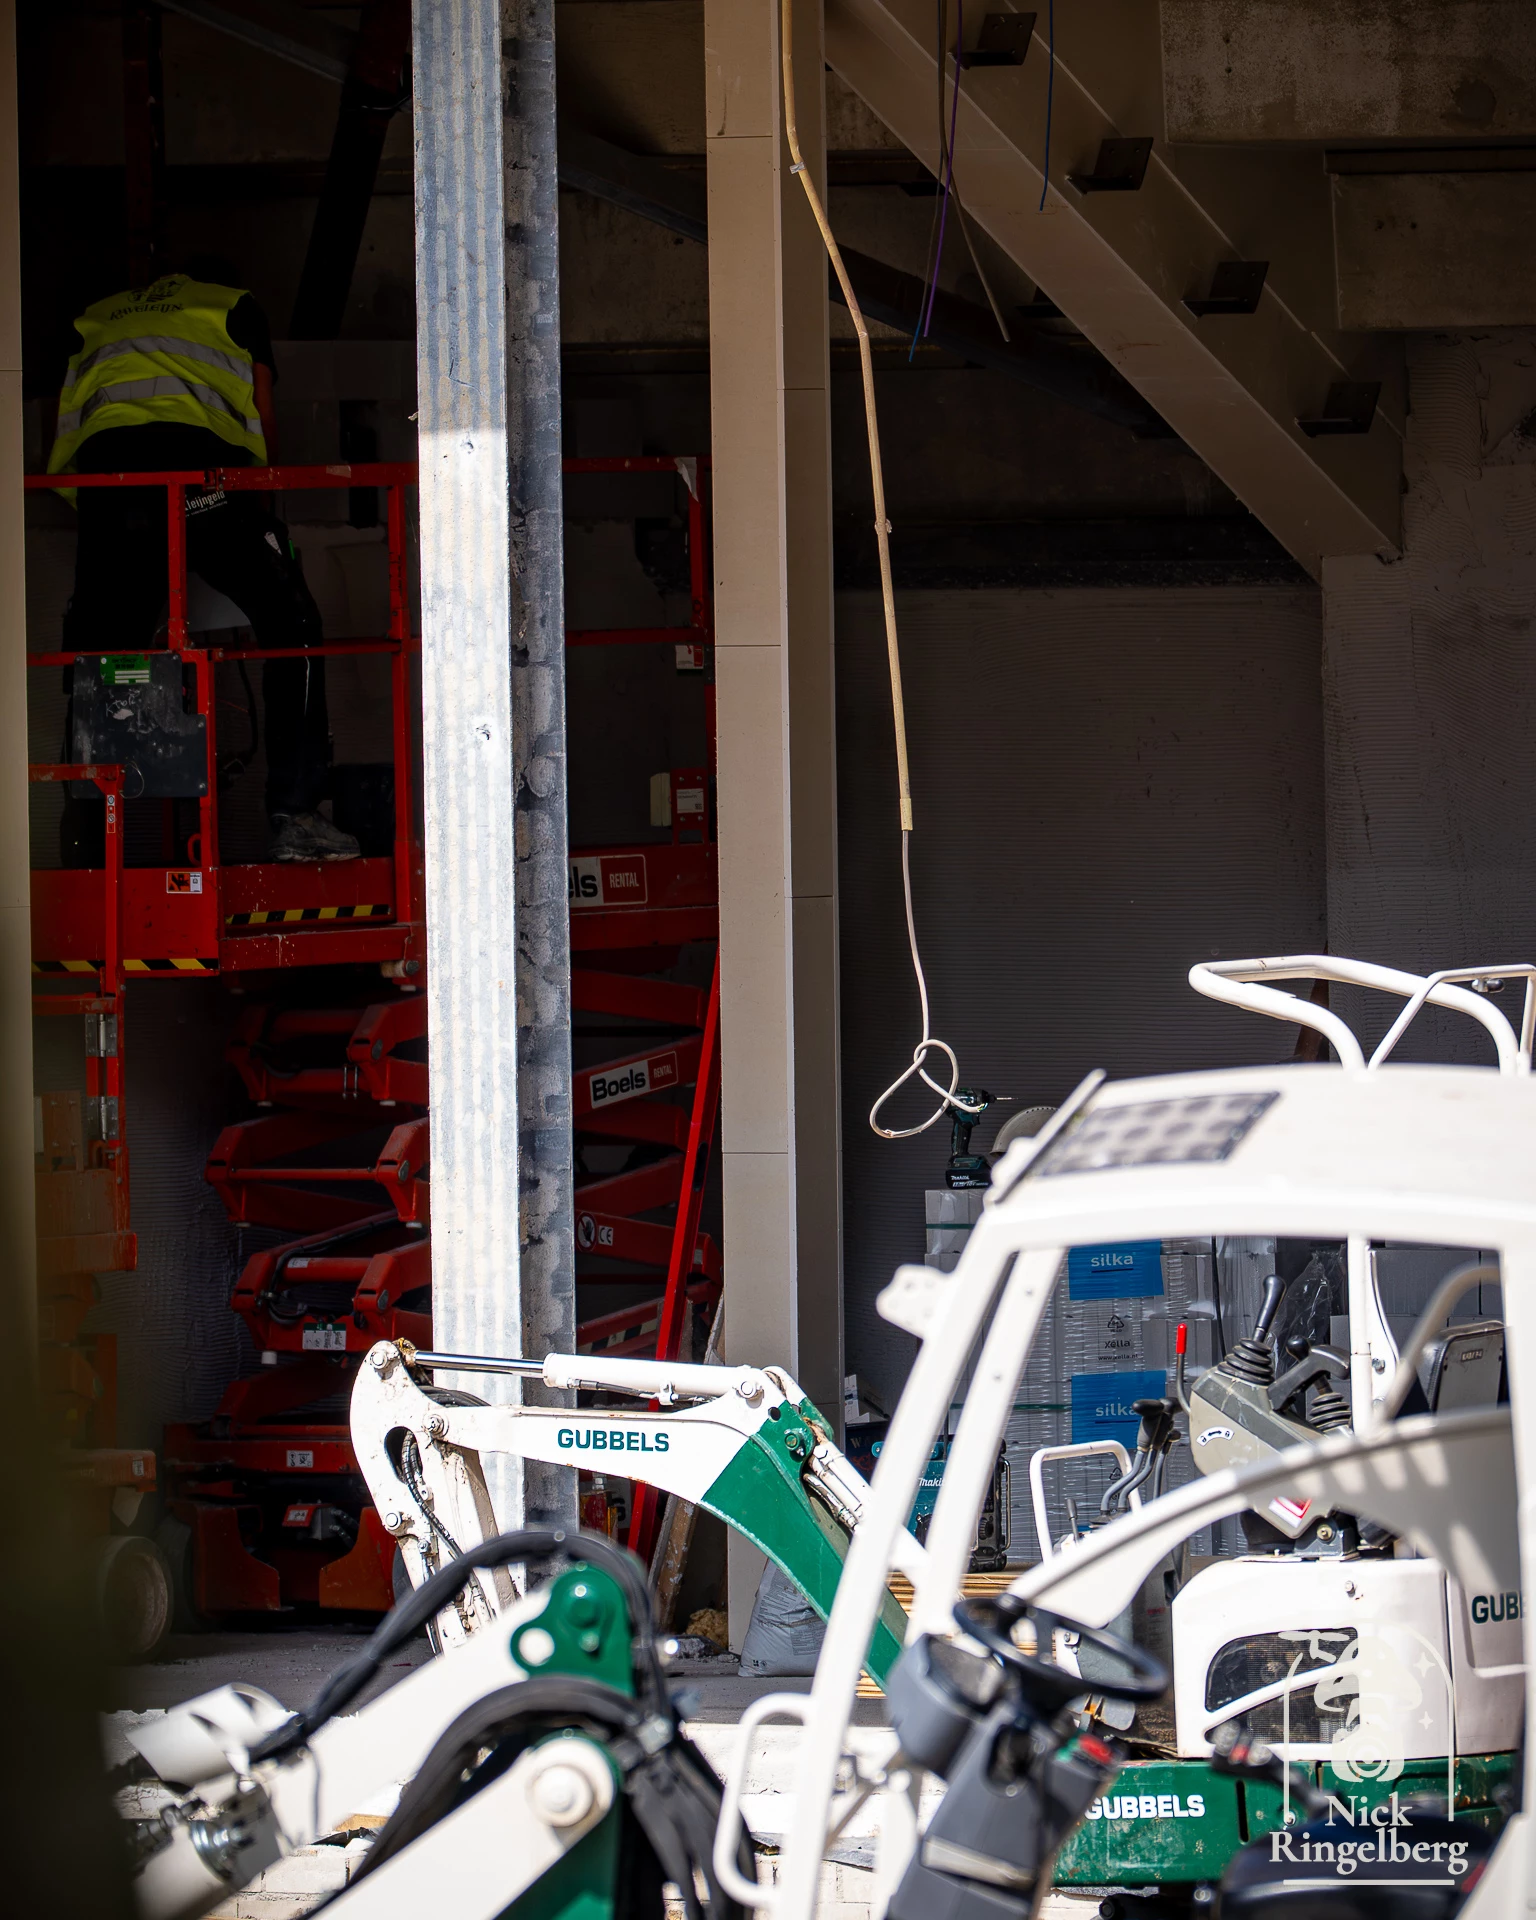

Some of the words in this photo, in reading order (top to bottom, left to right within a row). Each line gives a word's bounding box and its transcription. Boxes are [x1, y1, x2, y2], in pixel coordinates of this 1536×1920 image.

[185, 490, 226, 511] leijngeld
[609, 872, 640, 889] RENTAL
[592, 1069, 646, 1101] Boels
[653, 1064, 673, 1079] RENTAL
[1090, 1253, 1134, 1268] silka
[1104, 1340, 1131, 1349] xella
[557, 1428, 670, 1452] GUBBELS
[1084, 1794, 1206, 1820] GUBBELS
